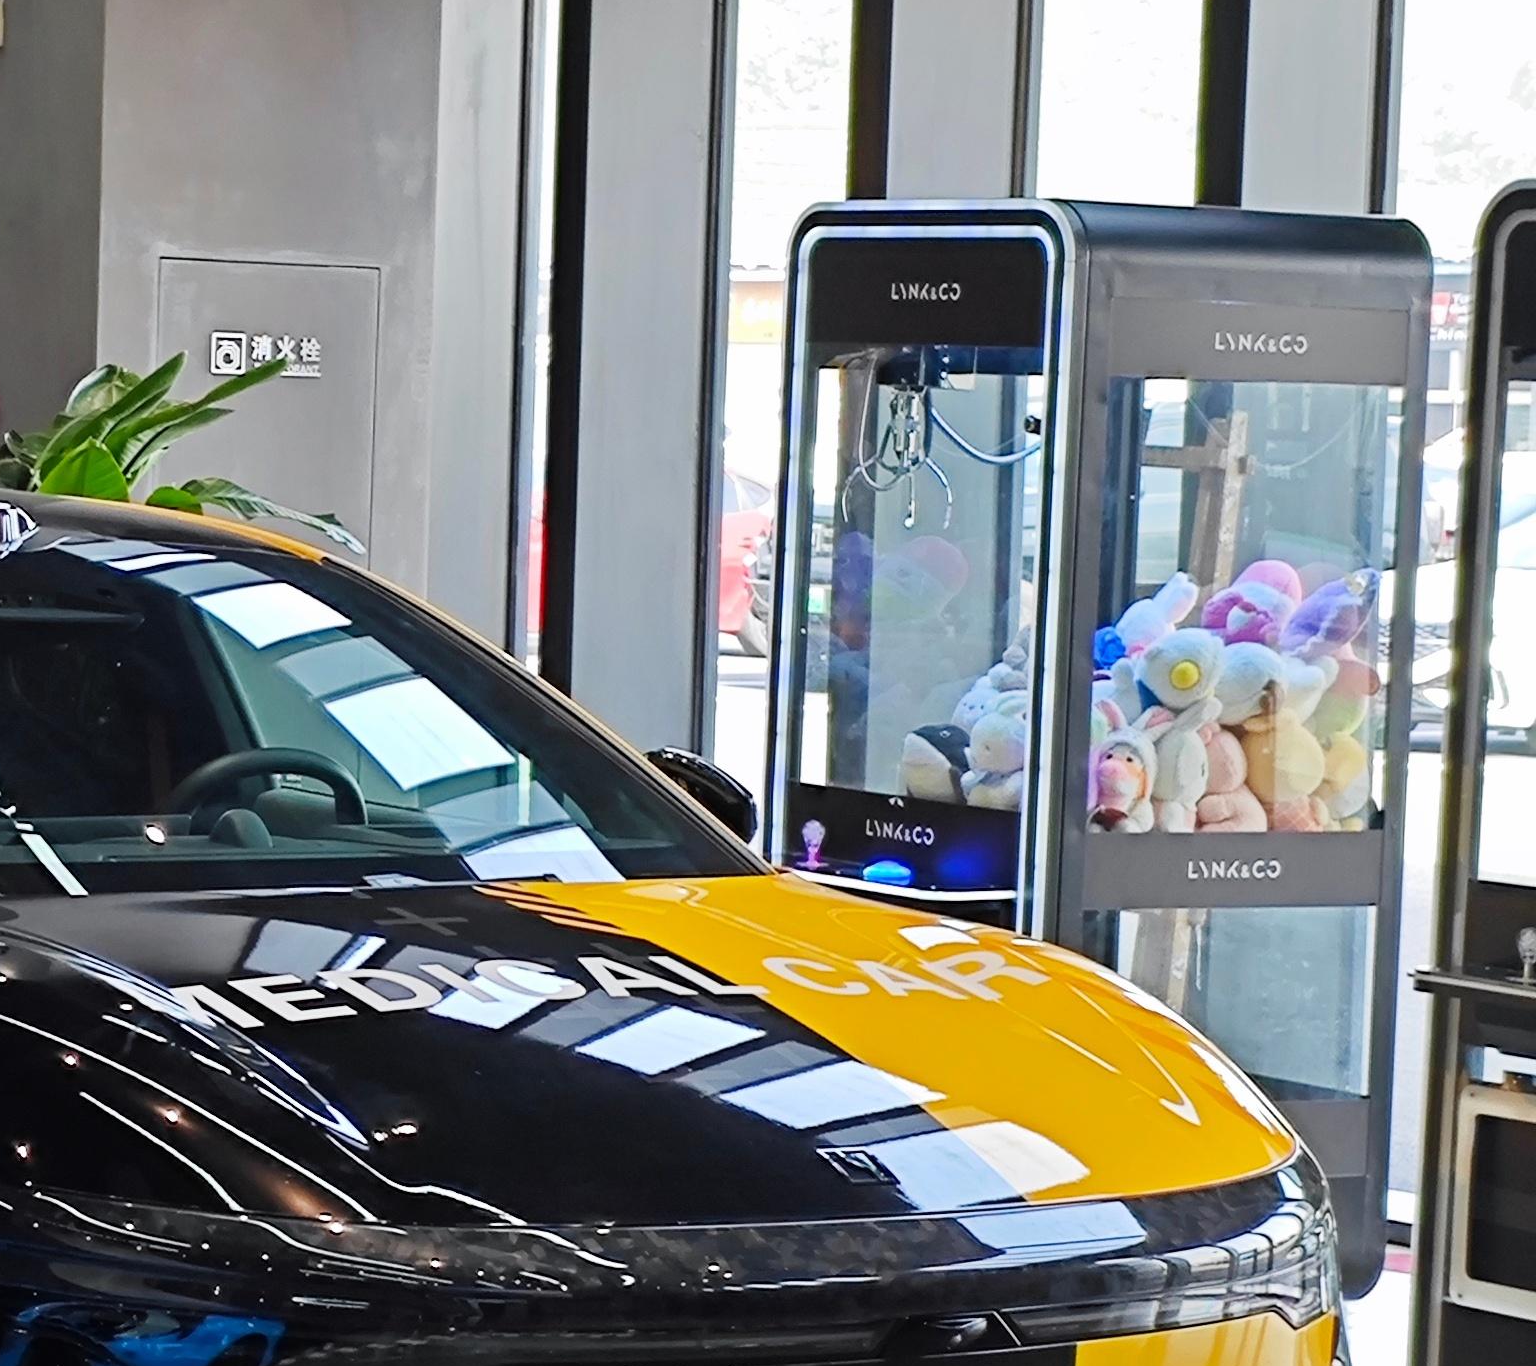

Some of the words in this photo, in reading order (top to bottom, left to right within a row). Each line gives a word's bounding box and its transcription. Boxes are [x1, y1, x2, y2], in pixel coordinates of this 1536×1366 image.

[250, 334, 322, 363] 消火栓
[170, 954, 769, 1031] MEDICAL
[762, 950, 1052, 1003] CAR
